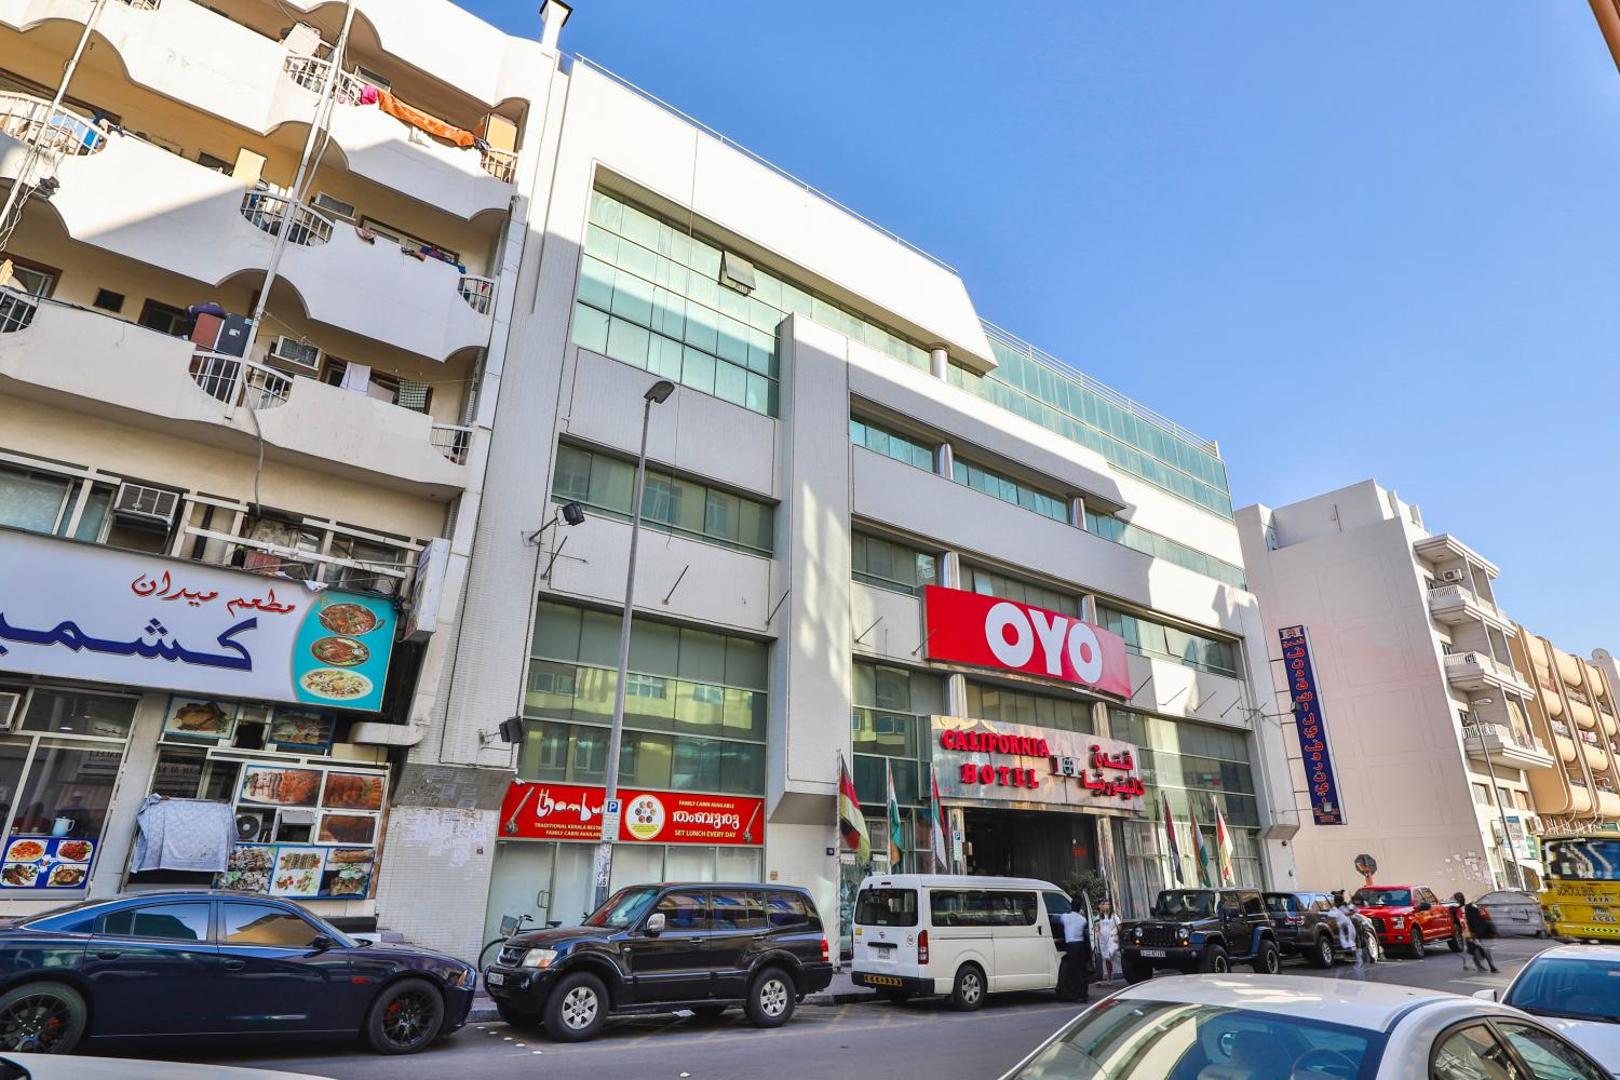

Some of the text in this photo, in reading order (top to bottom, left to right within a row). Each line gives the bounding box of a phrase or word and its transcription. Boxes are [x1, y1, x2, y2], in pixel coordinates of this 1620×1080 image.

[227, 588, 296, 618] مطعم
[985, 602, 1102, 684] OYO
[940, 729, 1051, 758] CALIFORNIA
[1090, 744, 1133, 770] فندق
[960, 763, 1039, 789] HOTEL
[1080, 769, 1145, 801] كاليفورنيا
[536, 788, 604, 822] thambu
